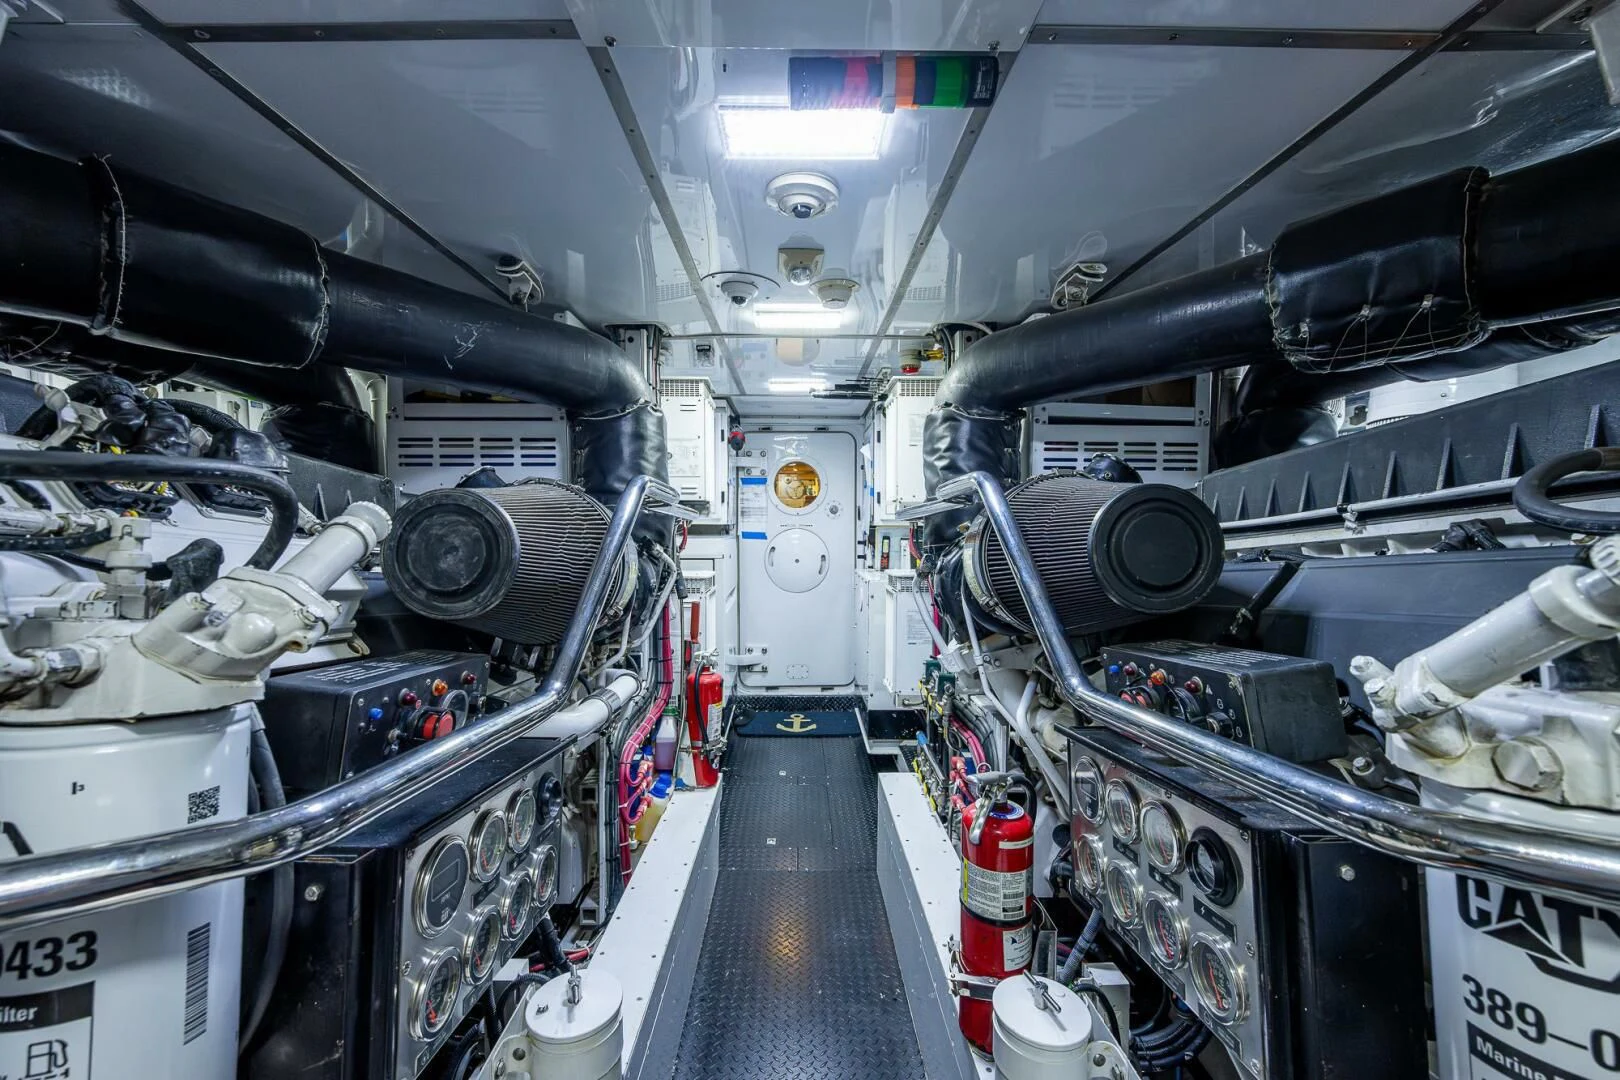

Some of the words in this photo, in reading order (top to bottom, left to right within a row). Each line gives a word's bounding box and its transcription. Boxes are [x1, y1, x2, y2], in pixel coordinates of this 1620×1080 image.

[1456, 873, 1594, 969] CAT
[0, 930, 98, 981] 433
[1476, 1035, 1547, 1080] Marine
